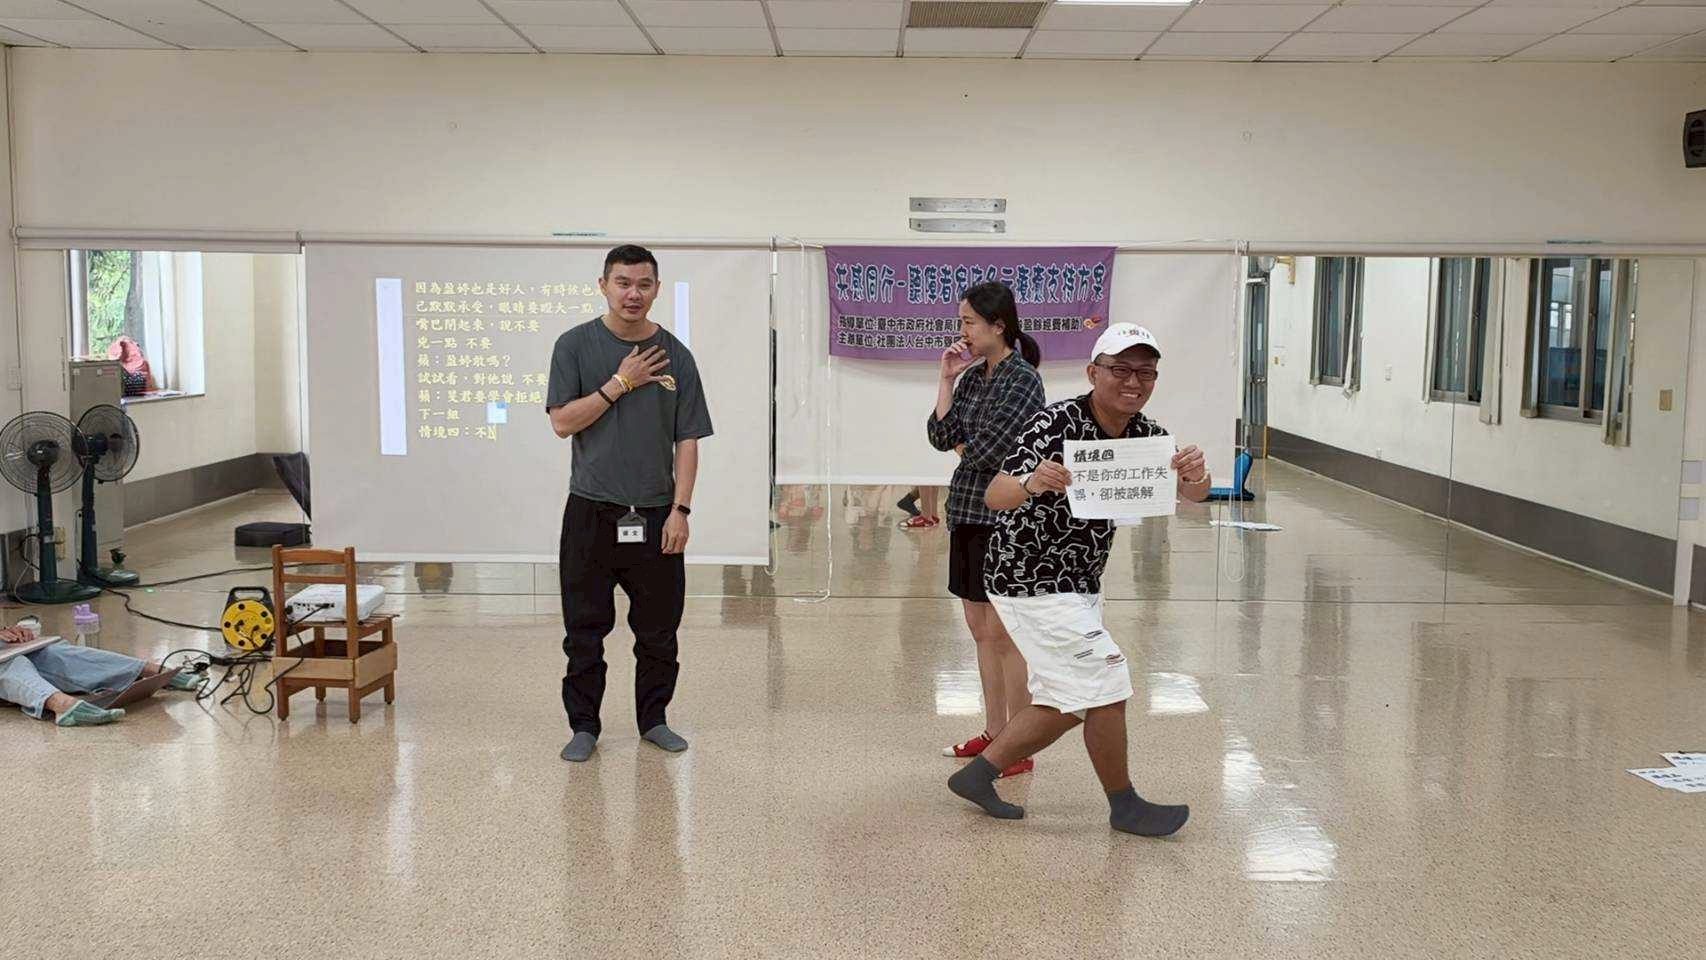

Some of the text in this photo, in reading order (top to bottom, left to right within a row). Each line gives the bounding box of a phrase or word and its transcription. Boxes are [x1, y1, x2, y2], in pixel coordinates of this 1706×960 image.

[419, 408, 459, 420] 下一組
[1073, 448, 1114, 463] 情境四
[1073, 466, 1168, 482] 不是你的工作失
